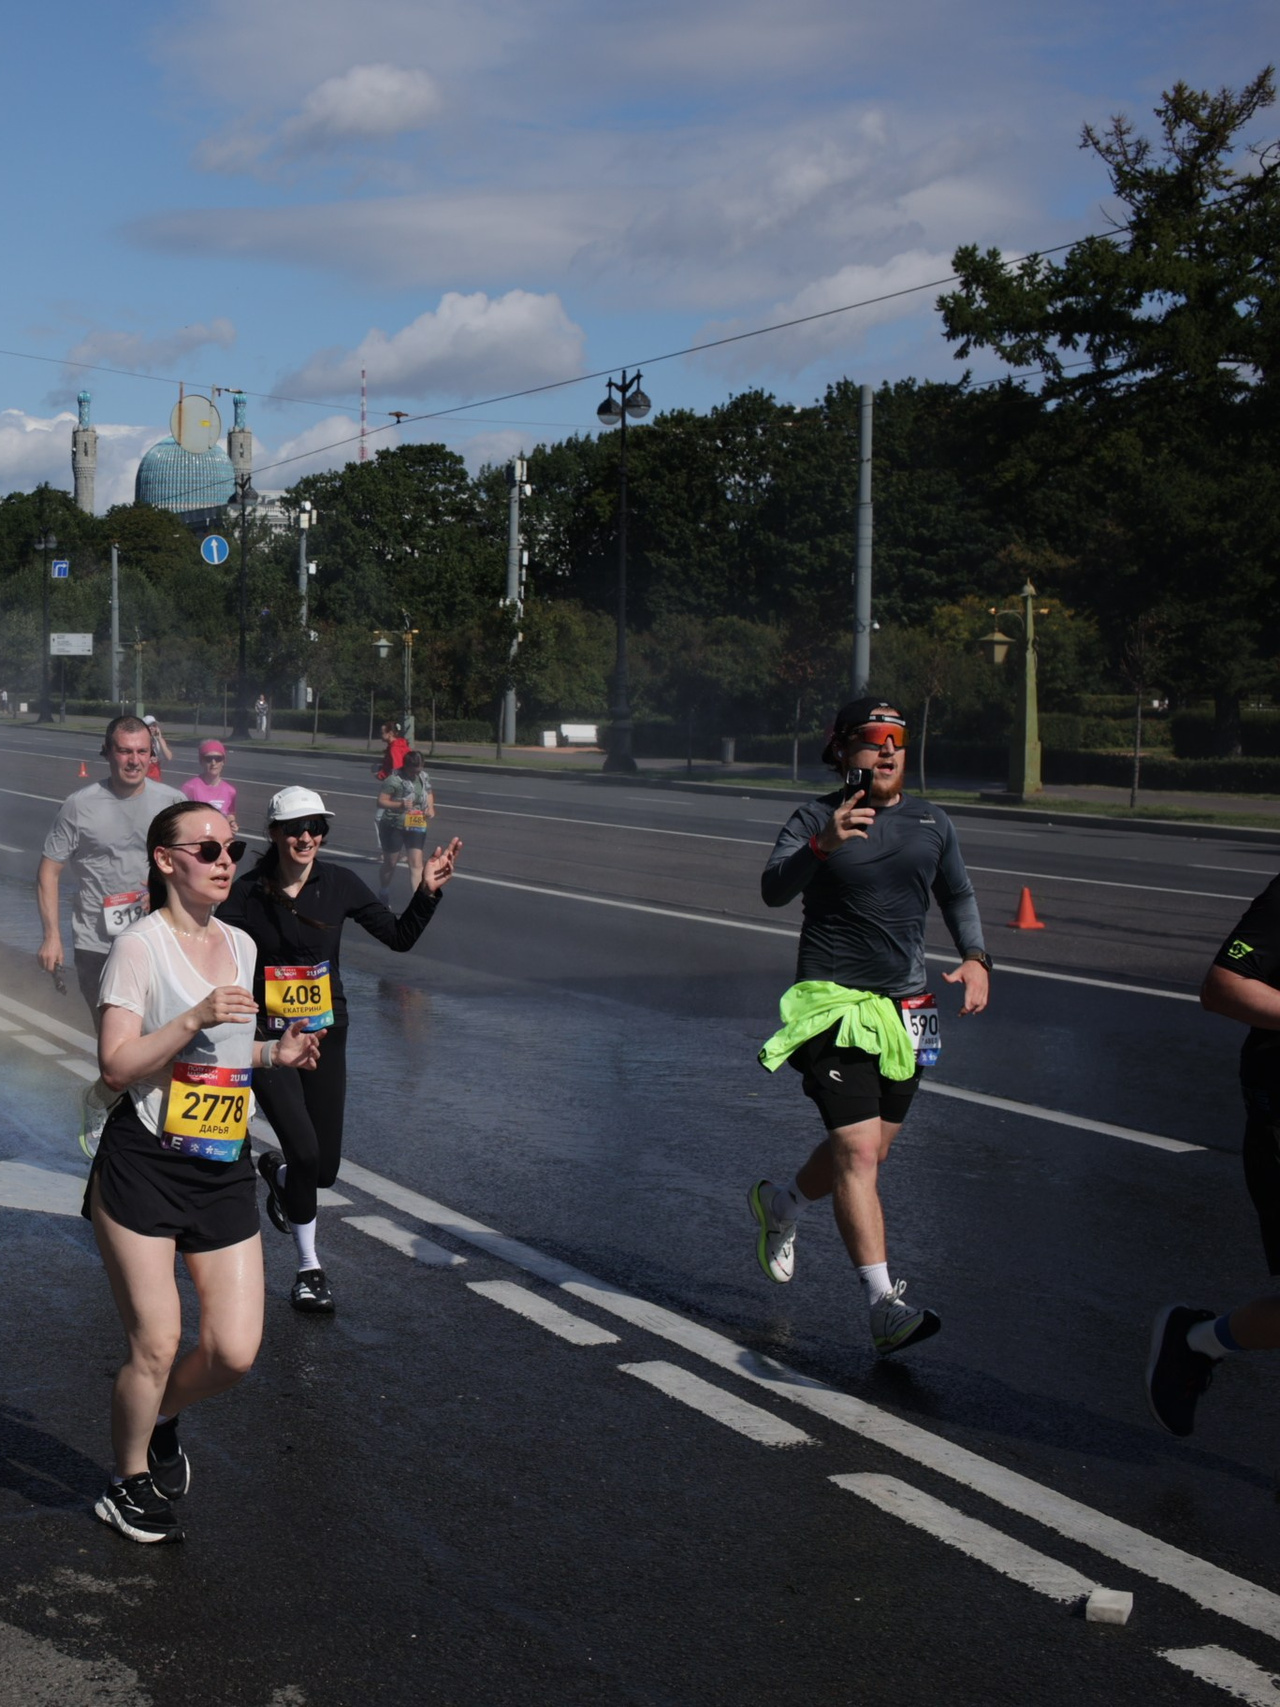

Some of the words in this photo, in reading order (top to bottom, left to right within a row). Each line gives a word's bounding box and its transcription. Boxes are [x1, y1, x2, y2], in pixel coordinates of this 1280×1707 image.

[282, 985, 321, 1006] 408
[181, 1092, 244, 1124] 2778
[199, 1124, 230, 1135] ДАРЬЯ
